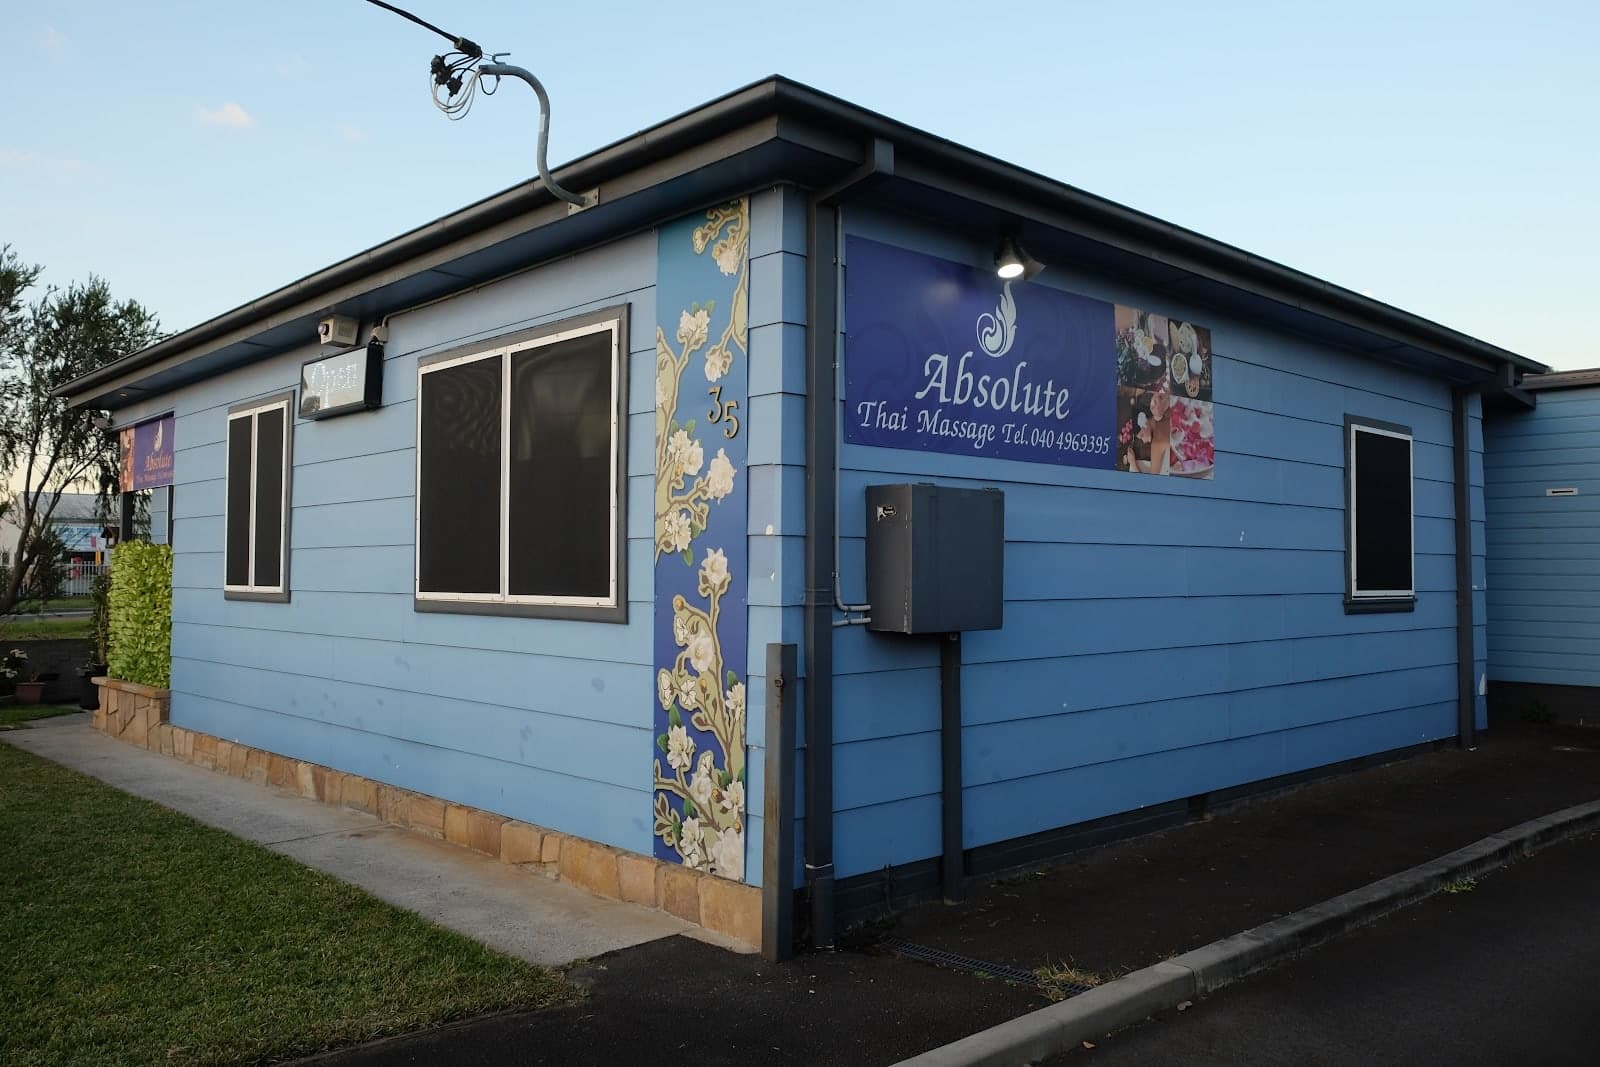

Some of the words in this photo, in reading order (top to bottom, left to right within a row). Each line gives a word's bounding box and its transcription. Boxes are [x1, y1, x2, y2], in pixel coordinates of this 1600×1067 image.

[707, 385, 740, 440] 35
[915, 351, 1070, 420] Absolute
[857, 400, 909, 431] Thai
[916, 408, 996, 449] Massage
[1002, 423, 1029, 445] Tel.
